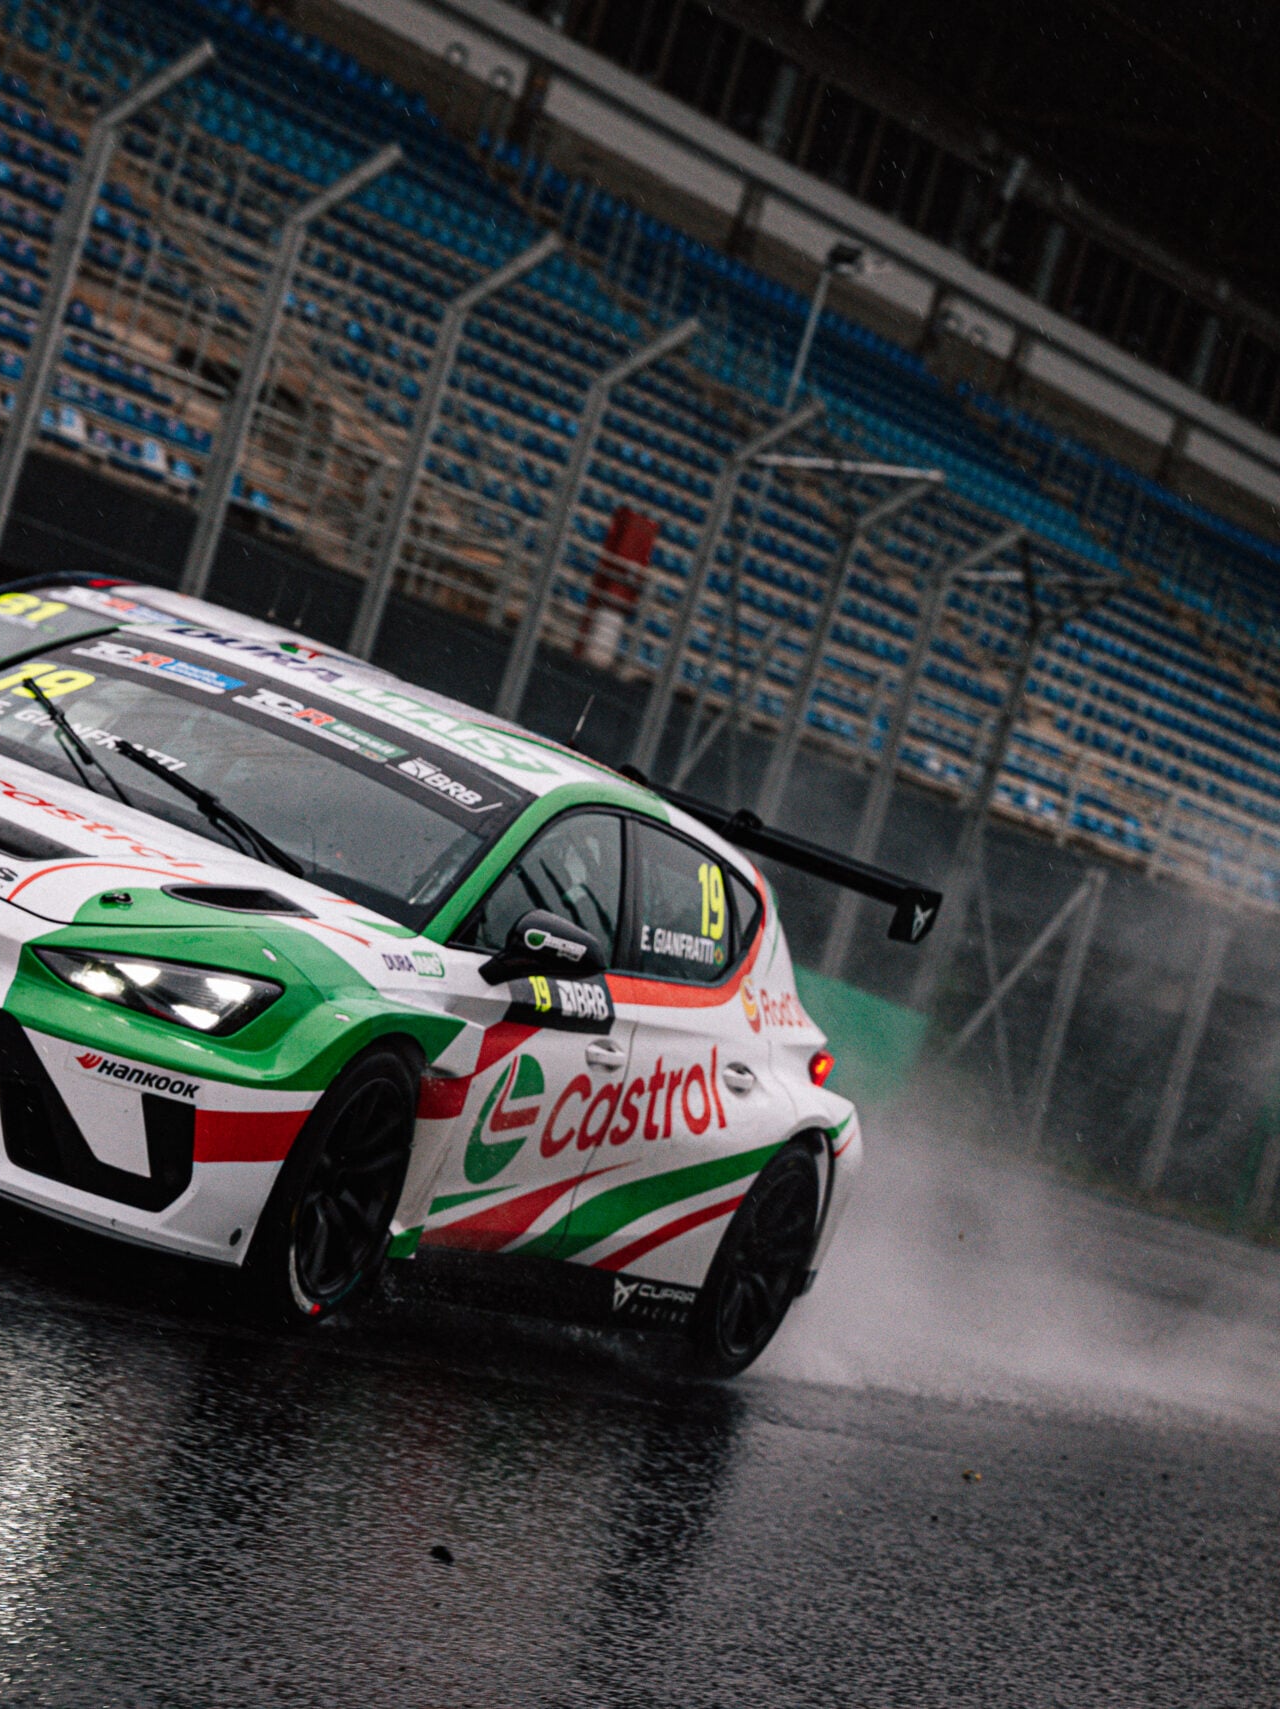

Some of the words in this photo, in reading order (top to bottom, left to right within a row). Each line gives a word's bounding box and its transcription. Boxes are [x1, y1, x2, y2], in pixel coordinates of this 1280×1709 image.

[88, 640, 174, 668] TCR
[247, 688, 336, 727] TCR
[424, 773, 482, 805] BRB
[698, 863, 725, 940] 19
[653, 927, 715, 965] GIANFRATTI
[528, 975, 552, 1012] 19
[572, 981, 609, 1021] BRB
[540, 1044, 727, 1159] Castrol
